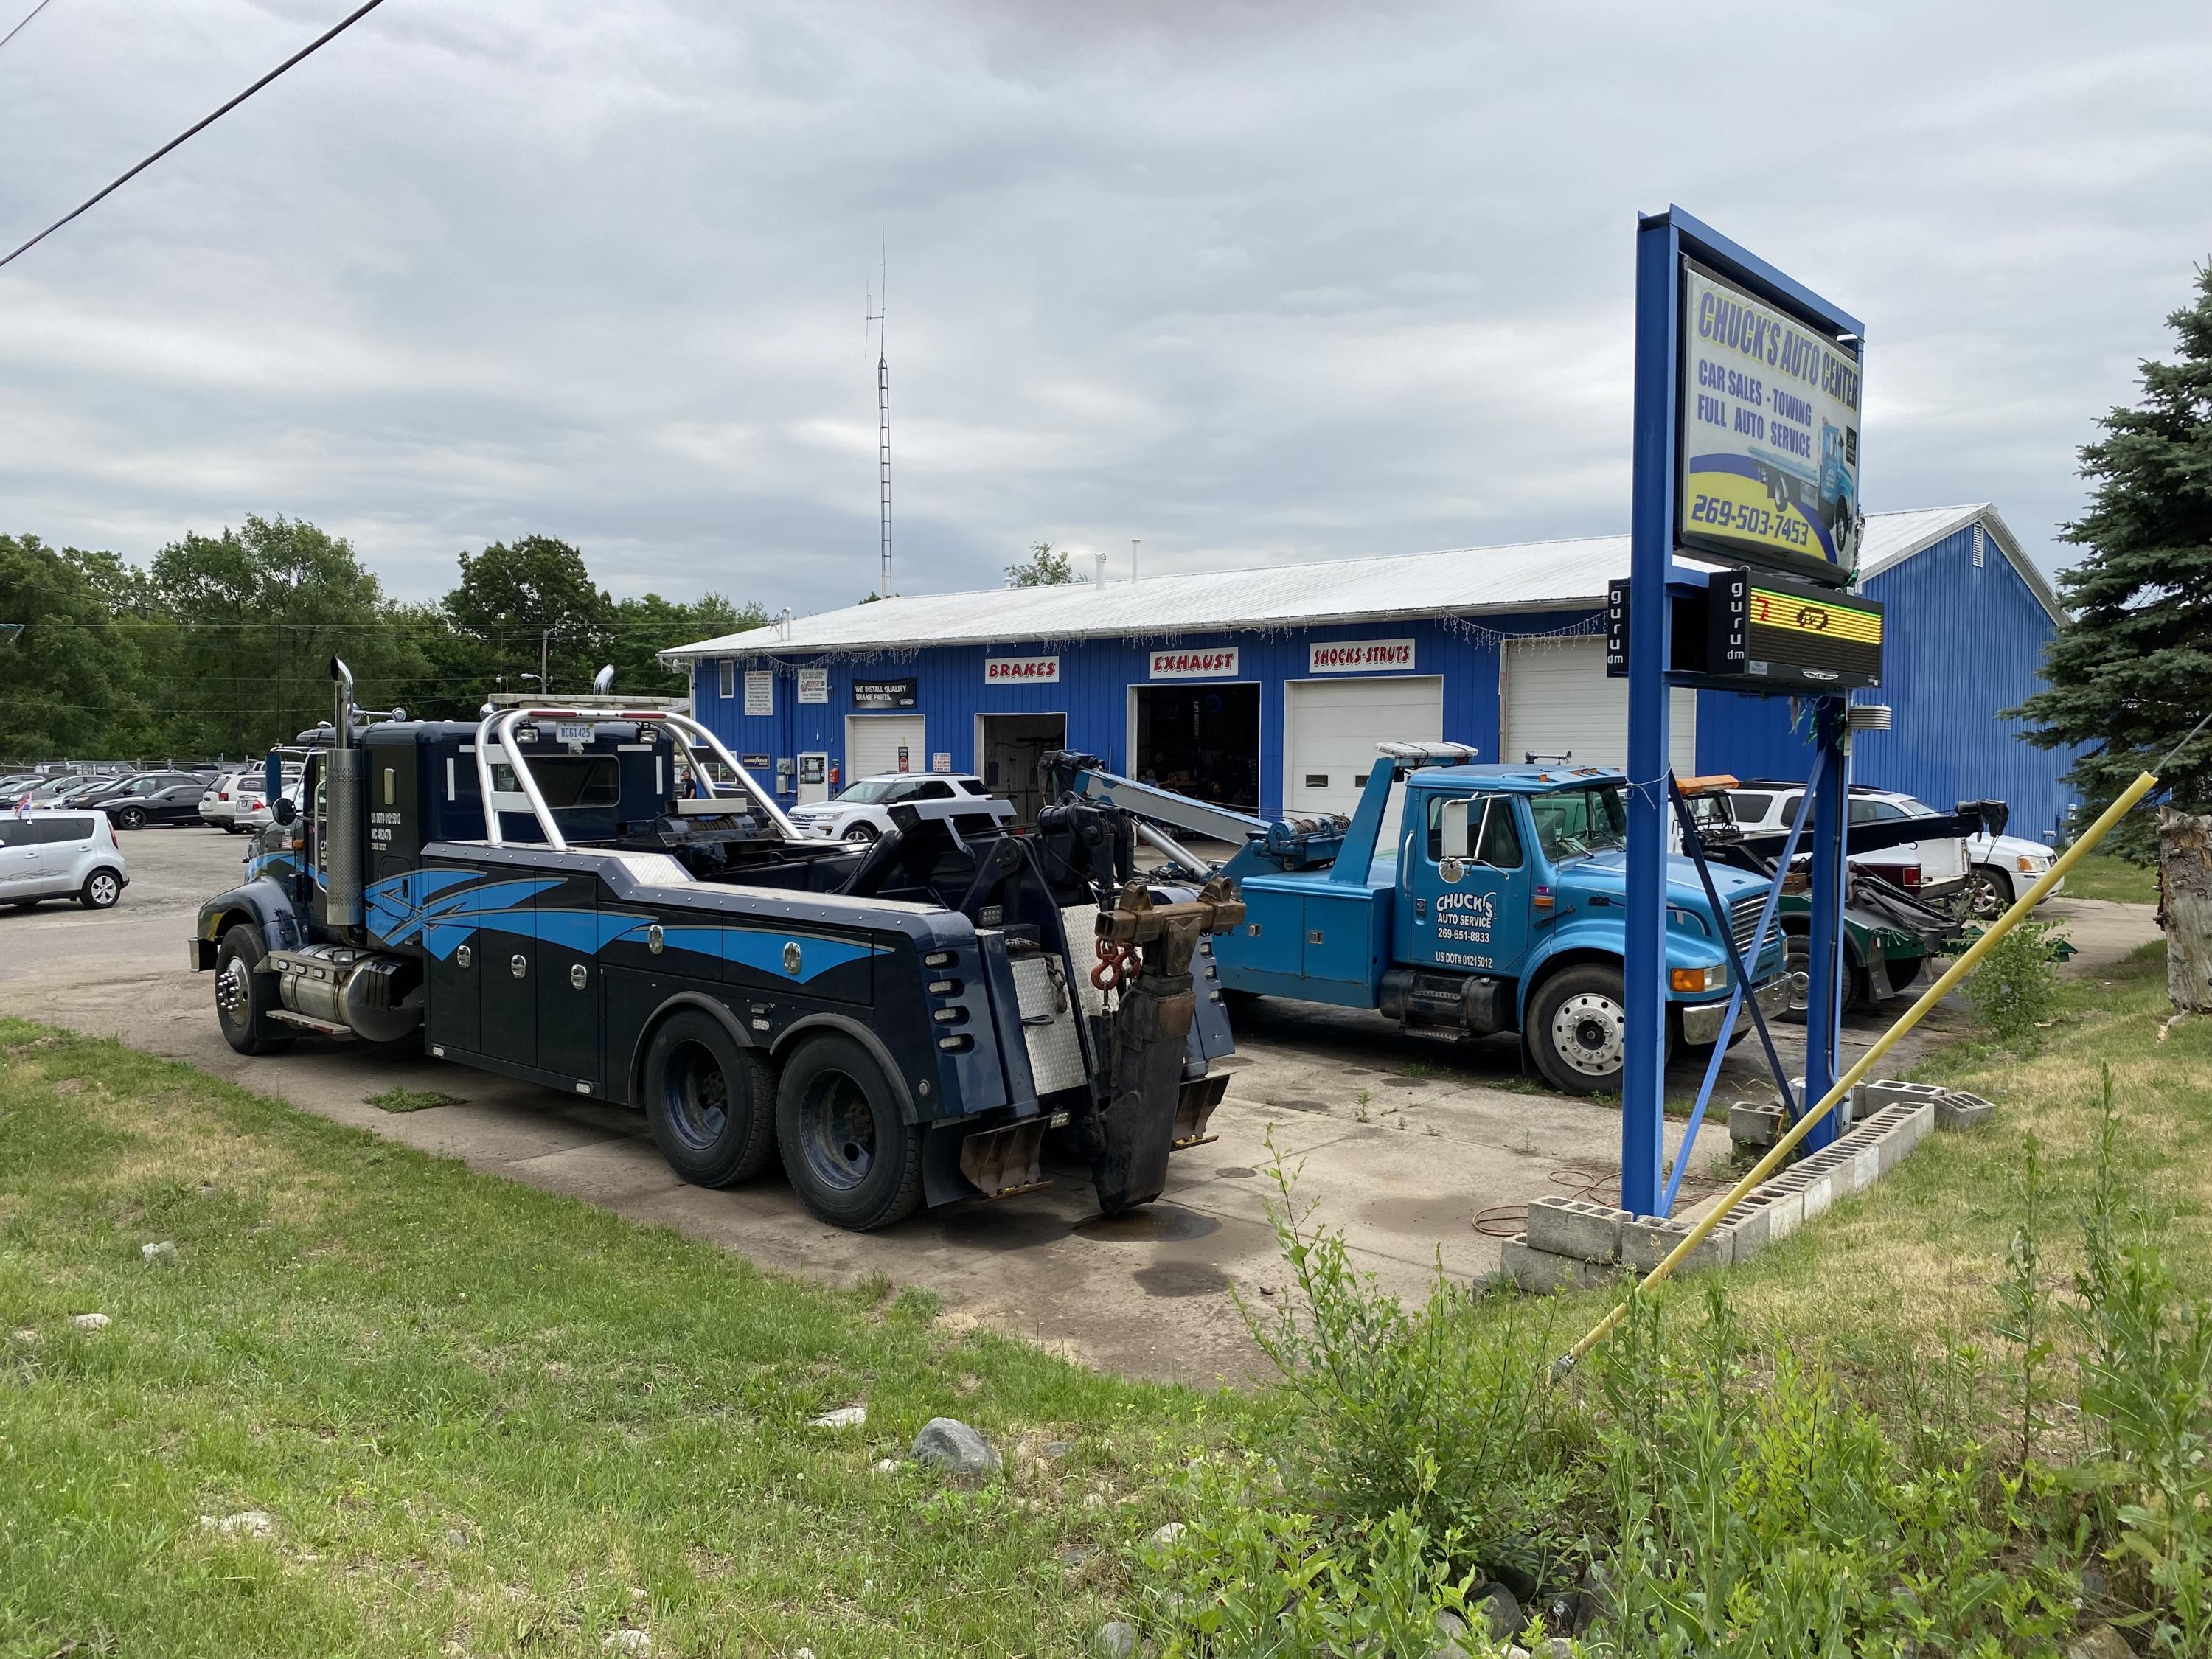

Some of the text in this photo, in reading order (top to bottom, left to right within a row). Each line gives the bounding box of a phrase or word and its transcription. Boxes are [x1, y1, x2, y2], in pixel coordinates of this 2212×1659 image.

[1697, 291, 1858, 412] CHUCK'S AUTO CENTER
[1698, 358, 1725, 393] CAR
[1728, 372, 1762, 406] SALES
[1773, 388, 1812, 428] TOWING
[1697, 394, 1726, 428] FULL
[1734, 406, 1764, 441] AUTO
[1770, 420, 1811, 459] SERVICE
[1691, 494, 1809, 546] 269-503-7453
[1153, 653, 1234, 672] EXHAUST
[1313, 644, 1411, 667] SHOCKS-STRUTS
[988, 661, 1056, 678] BRAKES
[884, 685, 907, 693] QUALITY
[561, 728, 590, 737] BC61425
[1436, 891, 1498, 919] CHUCK'S
[1438, 912, 1492, 928] AUTO SERVICE
[1437, 928, 1490, 943] 269-651-8833
[1436, 951, 1492, 969] US DOT# 01215012
